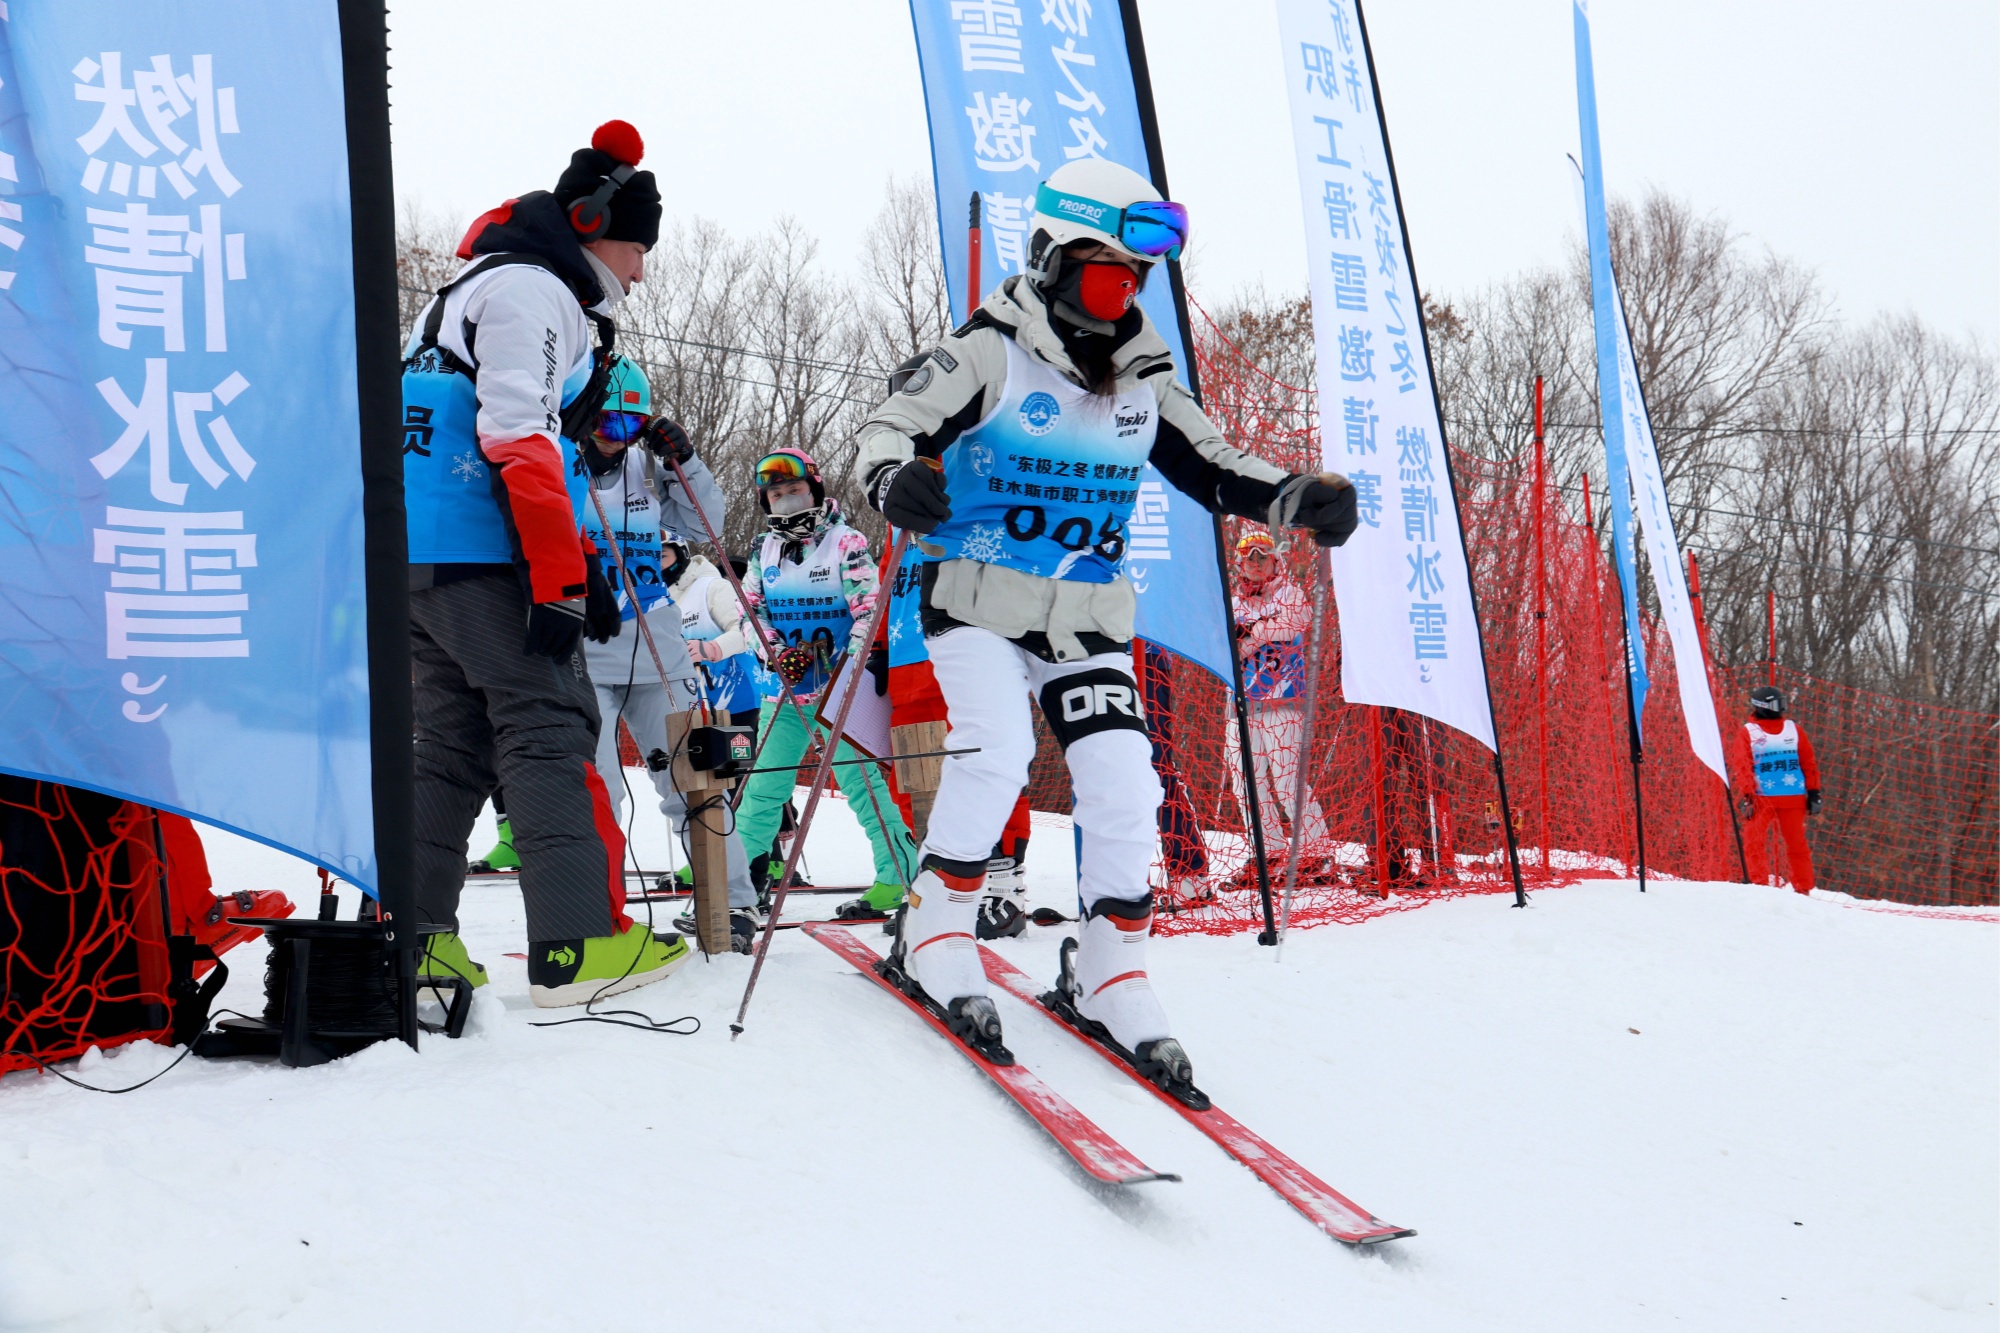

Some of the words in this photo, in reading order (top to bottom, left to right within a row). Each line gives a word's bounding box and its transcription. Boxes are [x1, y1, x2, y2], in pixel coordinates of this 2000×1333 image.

[1057, 199, 1103, 219] PROPRO
[542, 327, 558, 393] BEIJING
[1008, 453, 1089, 479] “东极之冬
[809, 567, 831, 578] Inski
[1759, 758, 1800, 774] 裁判员
